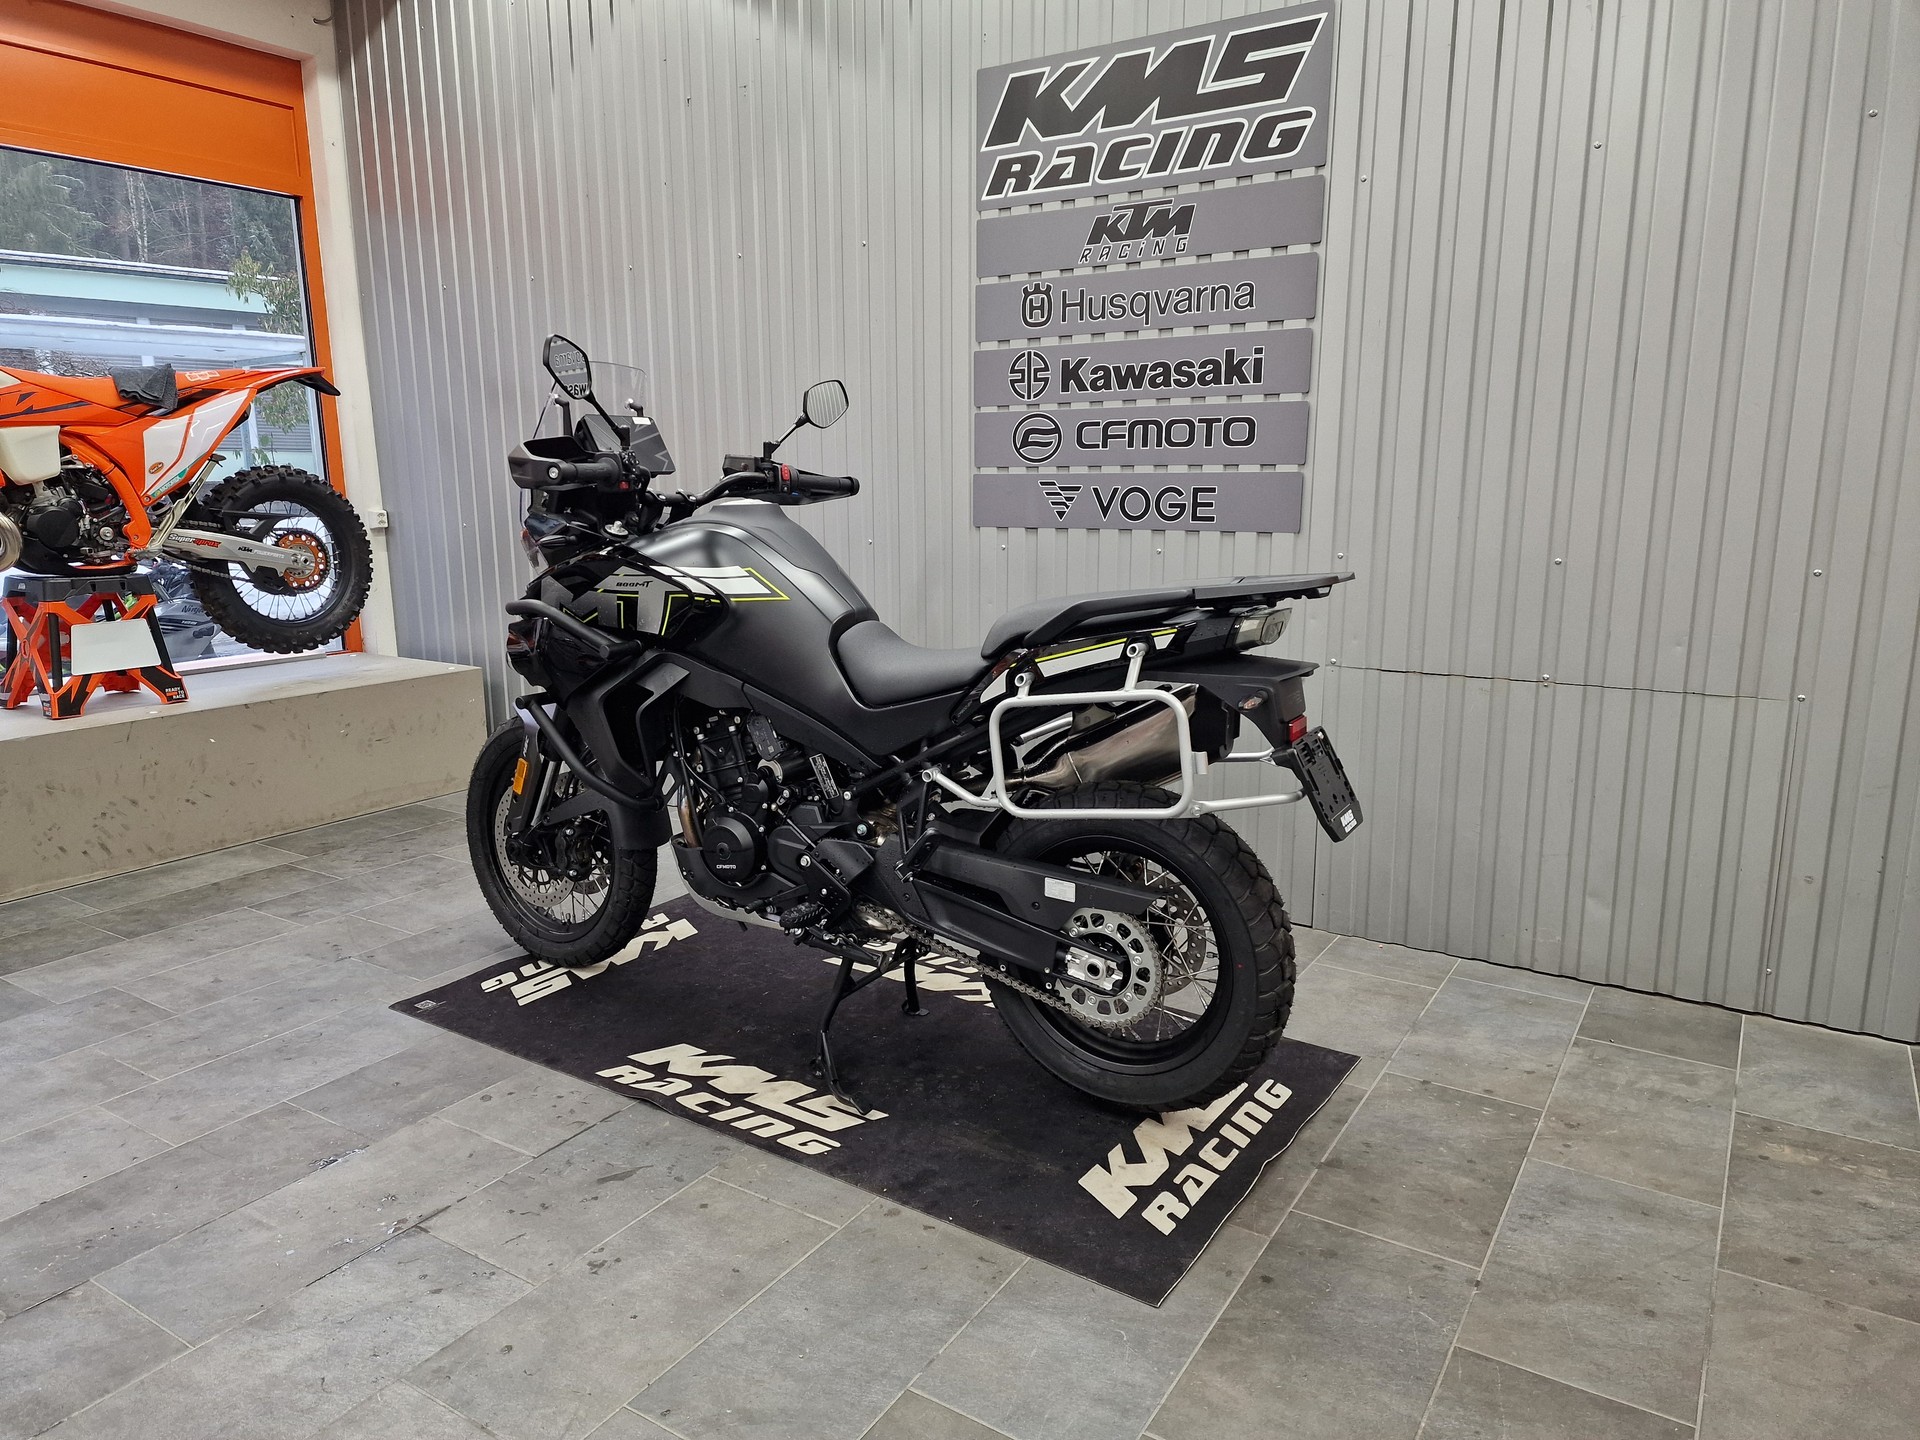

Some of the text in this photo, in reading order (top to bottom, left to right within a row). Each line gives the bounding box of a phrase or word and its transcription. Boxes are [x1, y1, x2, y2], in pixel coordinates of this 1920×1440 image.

[981, 12, 1328, 152] KMS
[981, 106, 1316, 201] RACING
[1085, 198, 1196, 246] KTM
[1060, 281, 1256, 326] Husqvarna
[1060, 346, 1265, 393] Kawasaki
[1075, 415, 1257, 449] CFMOTO
[1091, 485, 1218, 523] VOGE
[595, 1065, 841, 1155] RACING
[626, 1043, 889, 1132] KMS
[1141, 1079, 1292, 1236] RACING
